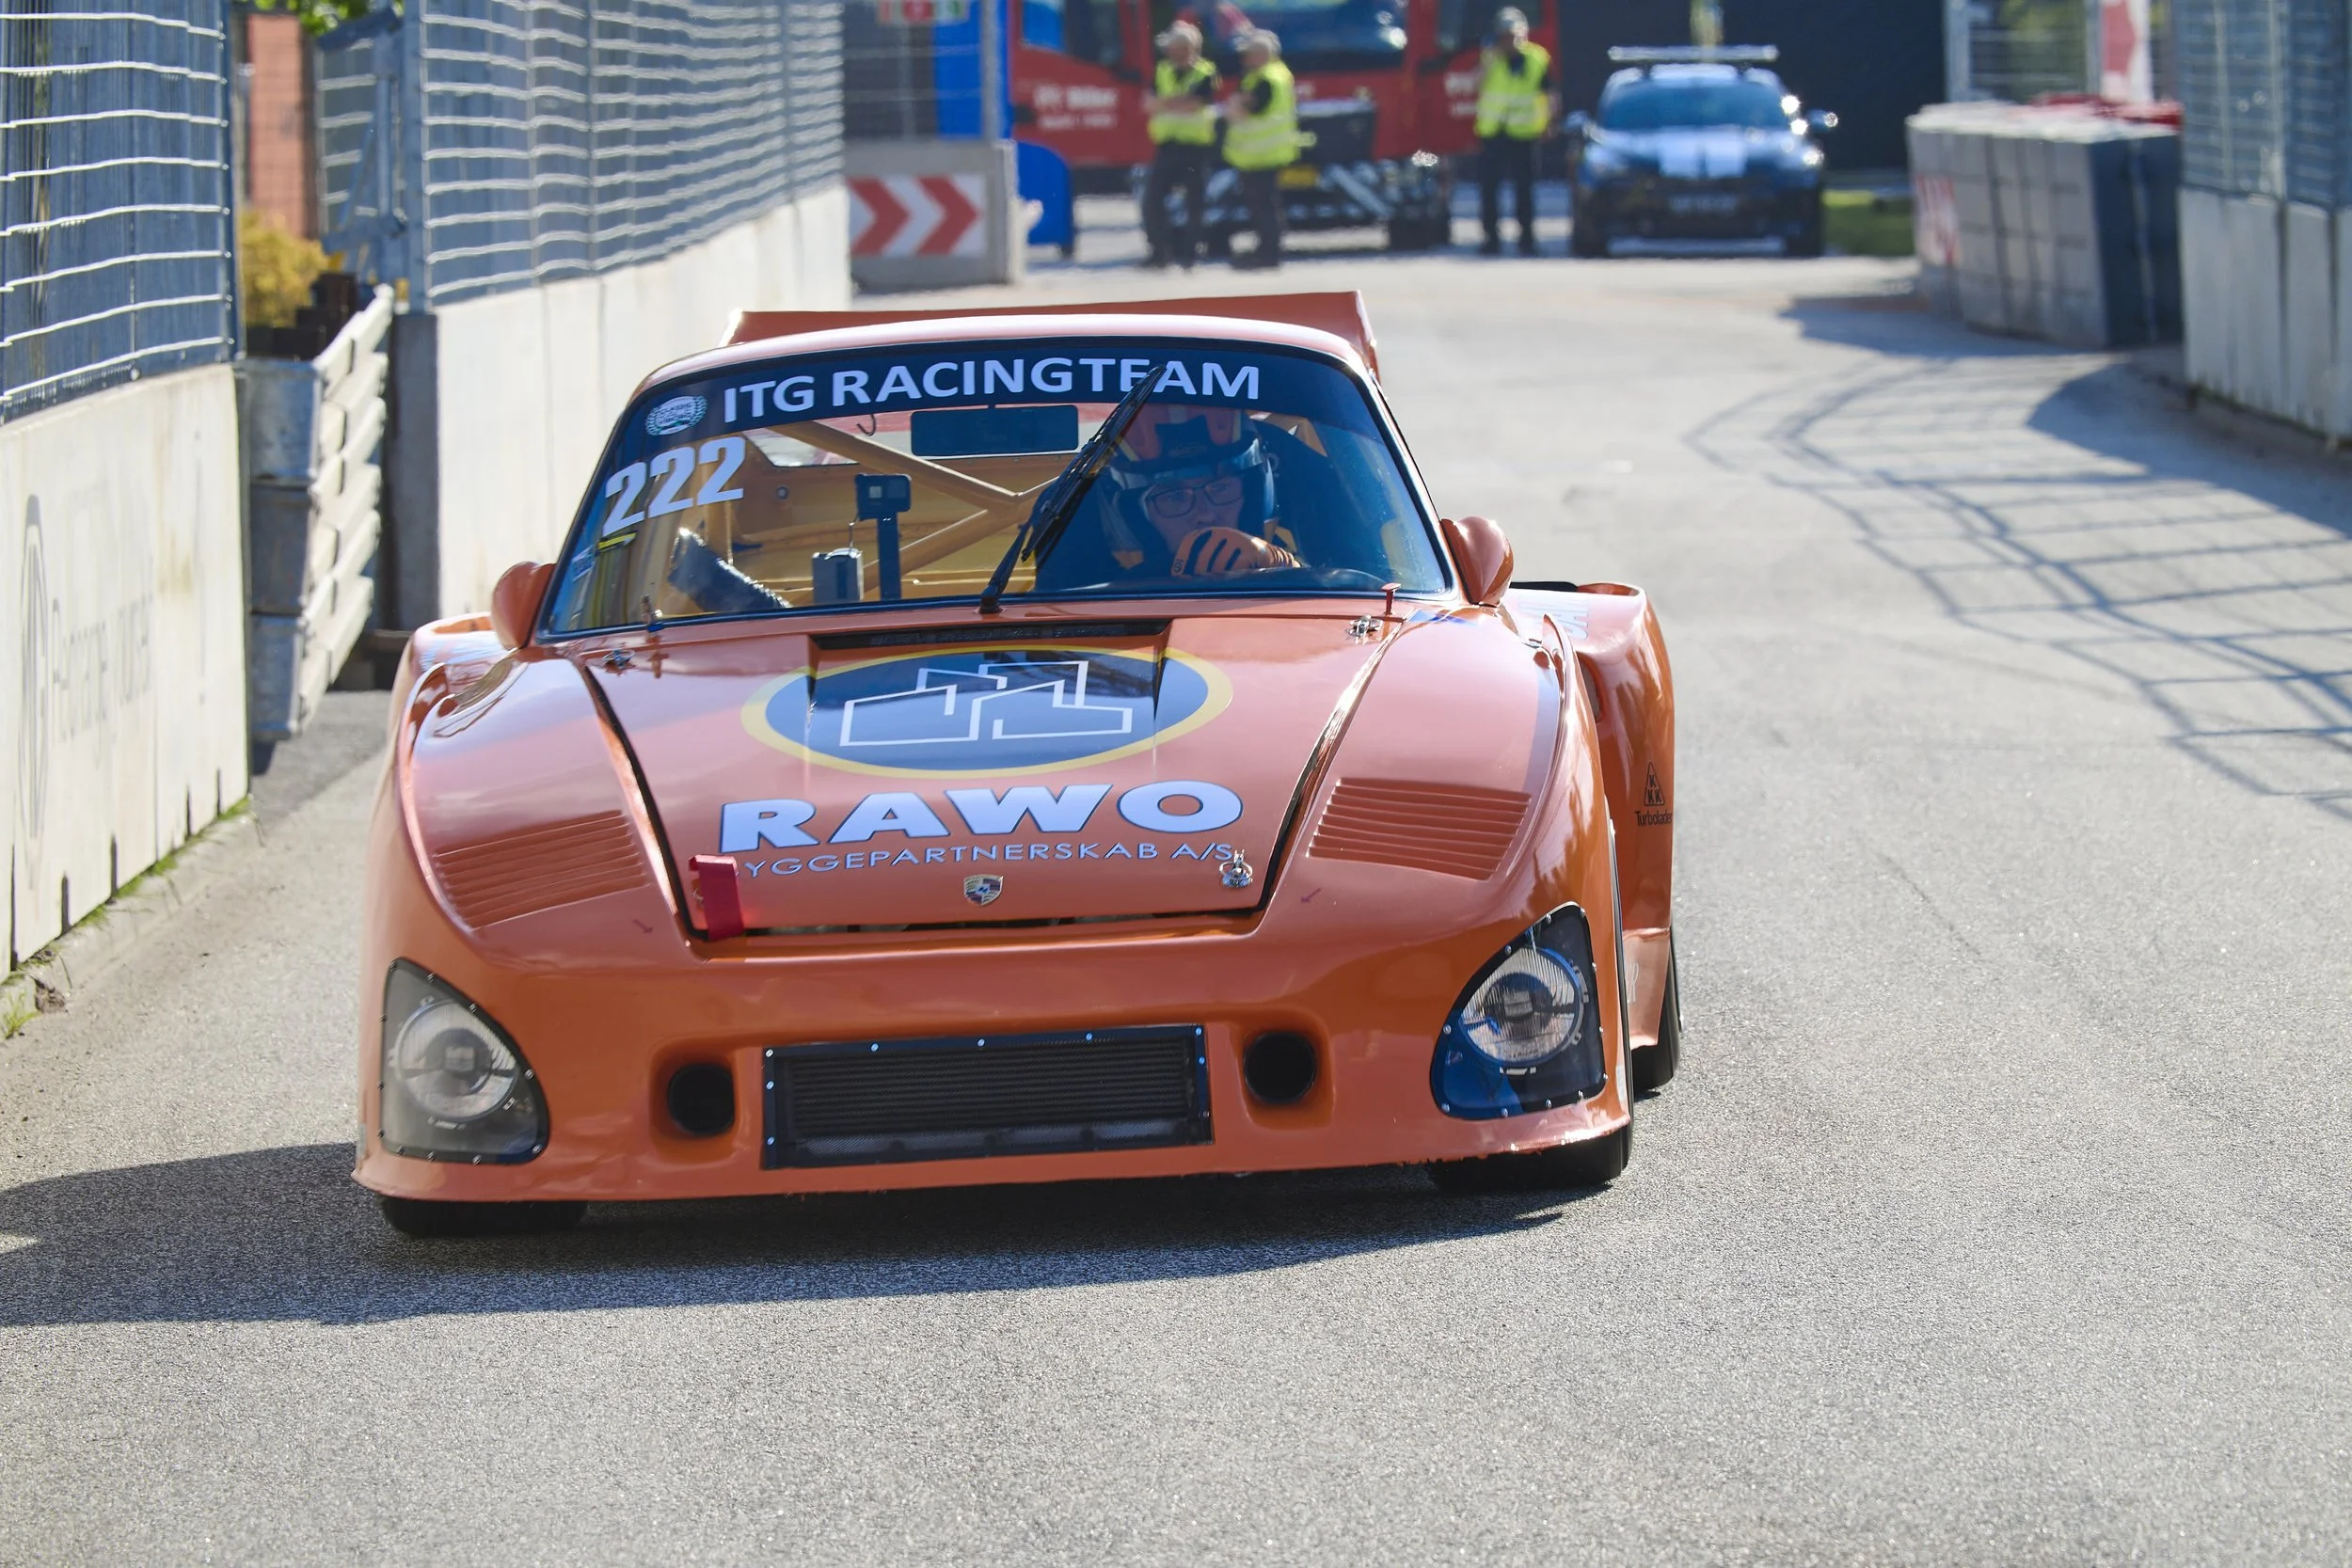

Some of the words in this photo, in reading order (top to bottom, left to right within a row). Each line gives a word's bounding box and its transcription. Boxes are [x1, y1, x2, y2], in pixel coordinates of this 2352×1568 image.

[723, 375, 815, 423] ITG
[832, 357, 1260, 407] RACINGTEAM
[602, 436, 746, 536] 222
[720, 780, 1244, 853] RAWO
[1634, 809, 1673, 827] Turbolader
[738, 842, 1159, 879] YGGEPARTNERSKAB
[1170, 842, 1234, 861] A/S
